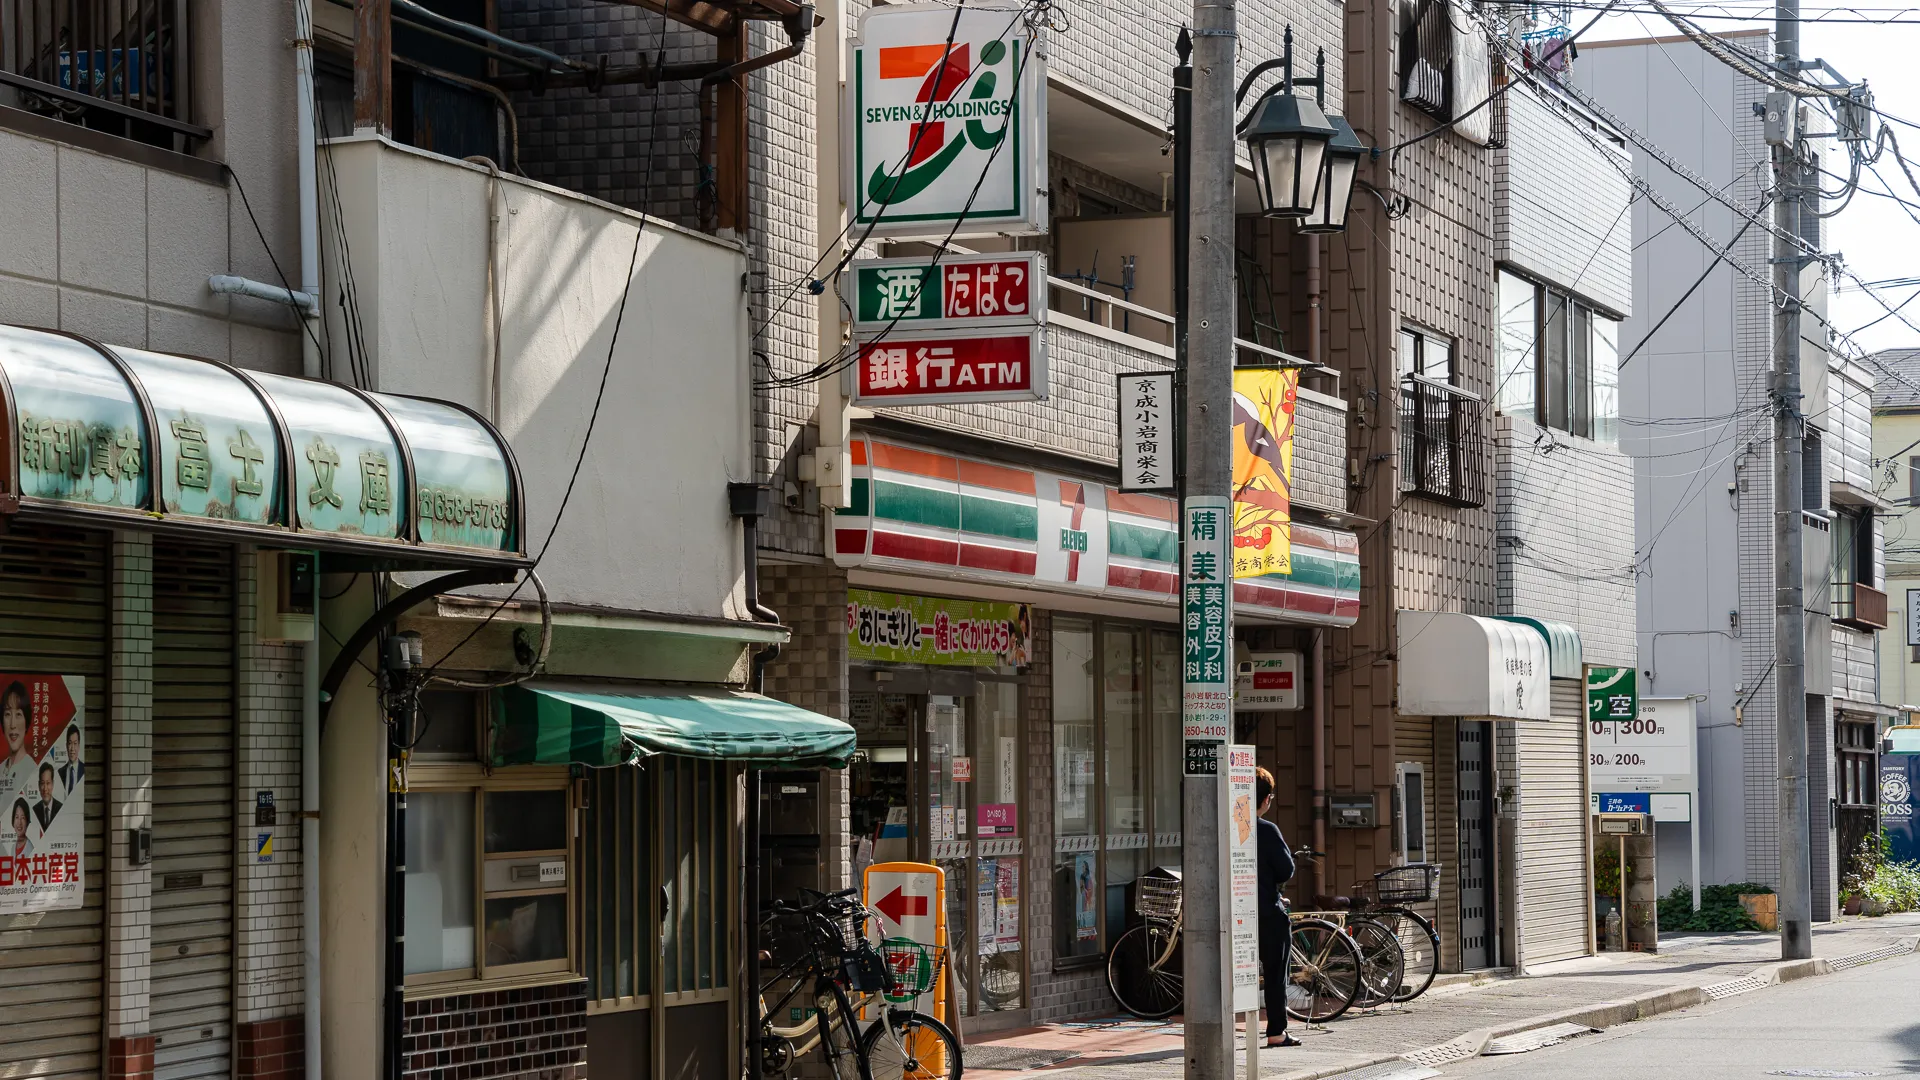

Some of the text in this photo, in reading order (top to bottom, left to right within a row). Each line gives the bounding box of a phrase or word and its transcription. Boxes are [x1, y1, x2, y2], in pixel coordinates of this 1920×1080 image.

[933, 99, 1008, 119] HOLDINGS
[877, 264, 1025, 320] 酒 たばこ
[1135, 379, 1160, 485] 京成小岩商栄会
[22, 417, 143, 481] 新刊貸本
[1191, 511, 1217, 580] 精美
[1187, 587, 1201, 681] 美容外科
[1204, 587, 1223, 681] 美容皮フ科
[1242, 695, 1284, 703] 三井住友銀行
[1608, 694, 1632, 717] 空
[1619, 719, 1666, 735] 300円
[1188, 747, 1217, 758] 北小岩
[1189, 760, 1217, 771] 6-16
[1881, 772, 1908, 783] COFFEE
[0, 852, 79, 887] 日本共産党
[0, 883, 77, 896] Japanese Communist Party
